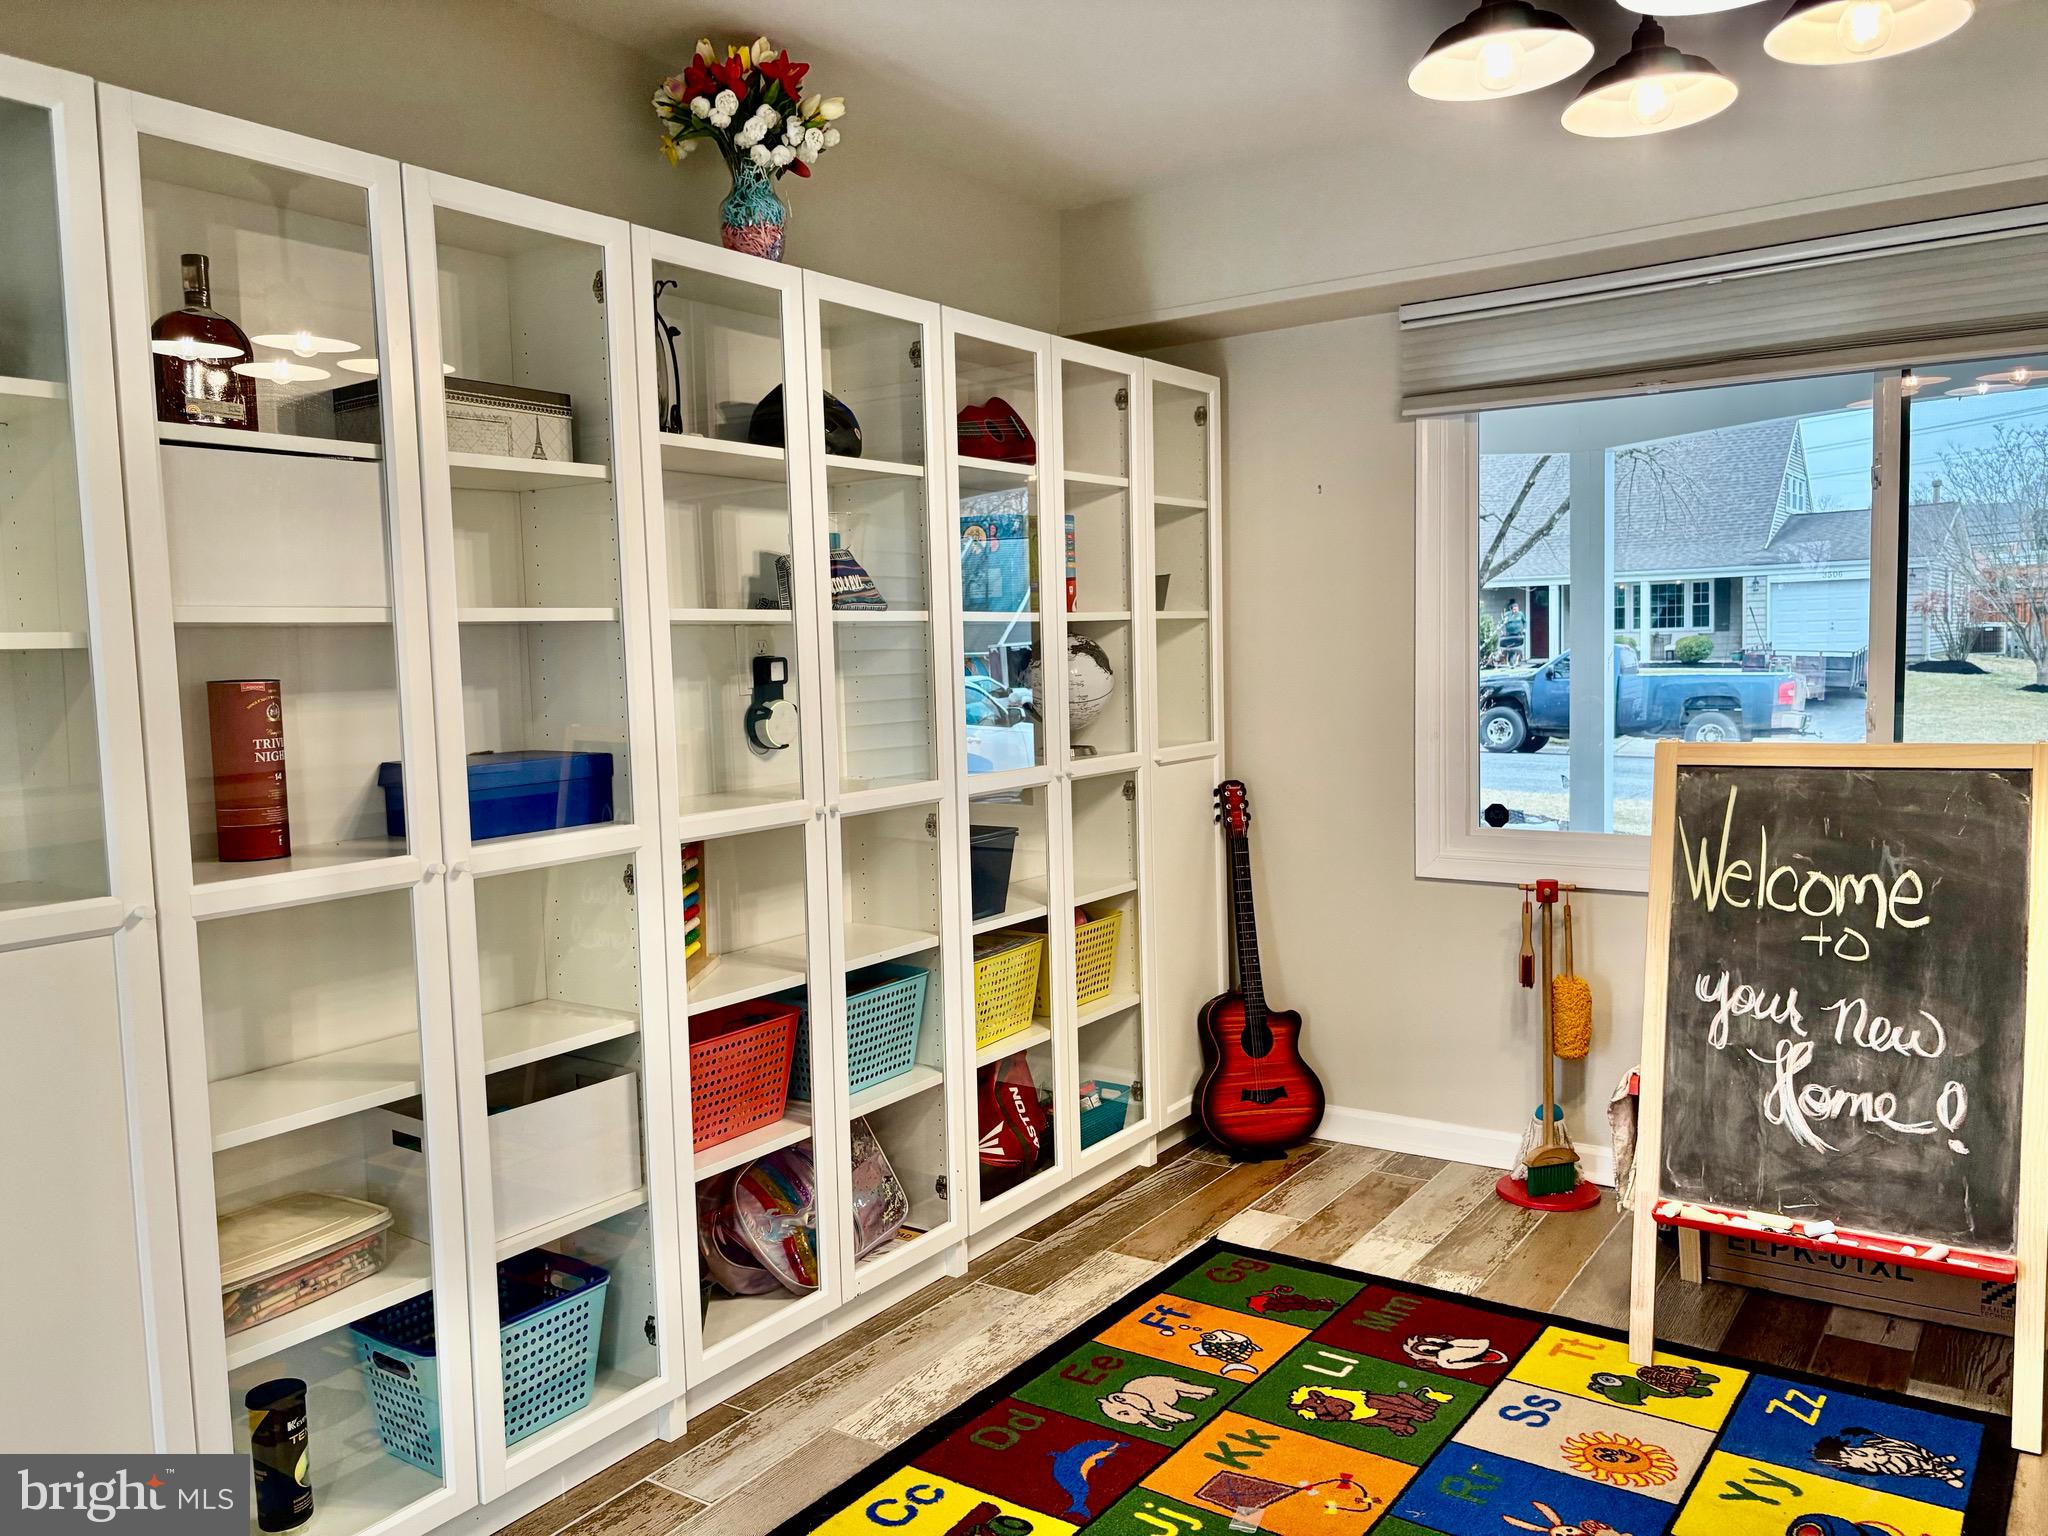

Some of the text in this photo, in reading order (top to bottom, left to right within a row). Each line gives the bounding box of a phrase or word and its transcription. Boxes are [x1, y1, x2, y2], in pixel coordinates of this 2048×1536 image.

[1679, 784, 1931, 930] Welcome
[1800, 920, 1870, 962] to
[1694, 970, 1808, 1050] your
[1008, 1086, 1041, 1149] ASTON
[1205, 1258, 1271, 1284] Gg
[1138, 1304, 1192, 1332] Ff
[1352, 1296, 1423, 1333] Mm
[1302, 1350, 1360, 1378] Ll
[1548, 1337, 1607, 1361] Tt
[1059, 1355, 1125, 1387] Ee
[1498, 1394, 1562, 1428] Ss
[1764, 1387, 1828, 1427] Zz
[969, 1407, 1047, 1451] Dd
[1203, 1428, 1281, 1470] Kk
[1439, 1462, 1505, 1505] Rr
[1718, 1467, 1804, 1506] Yy
[865, 1484, 945, 1528] Cc
[1133, 1502, 1203, 1536] Jj
